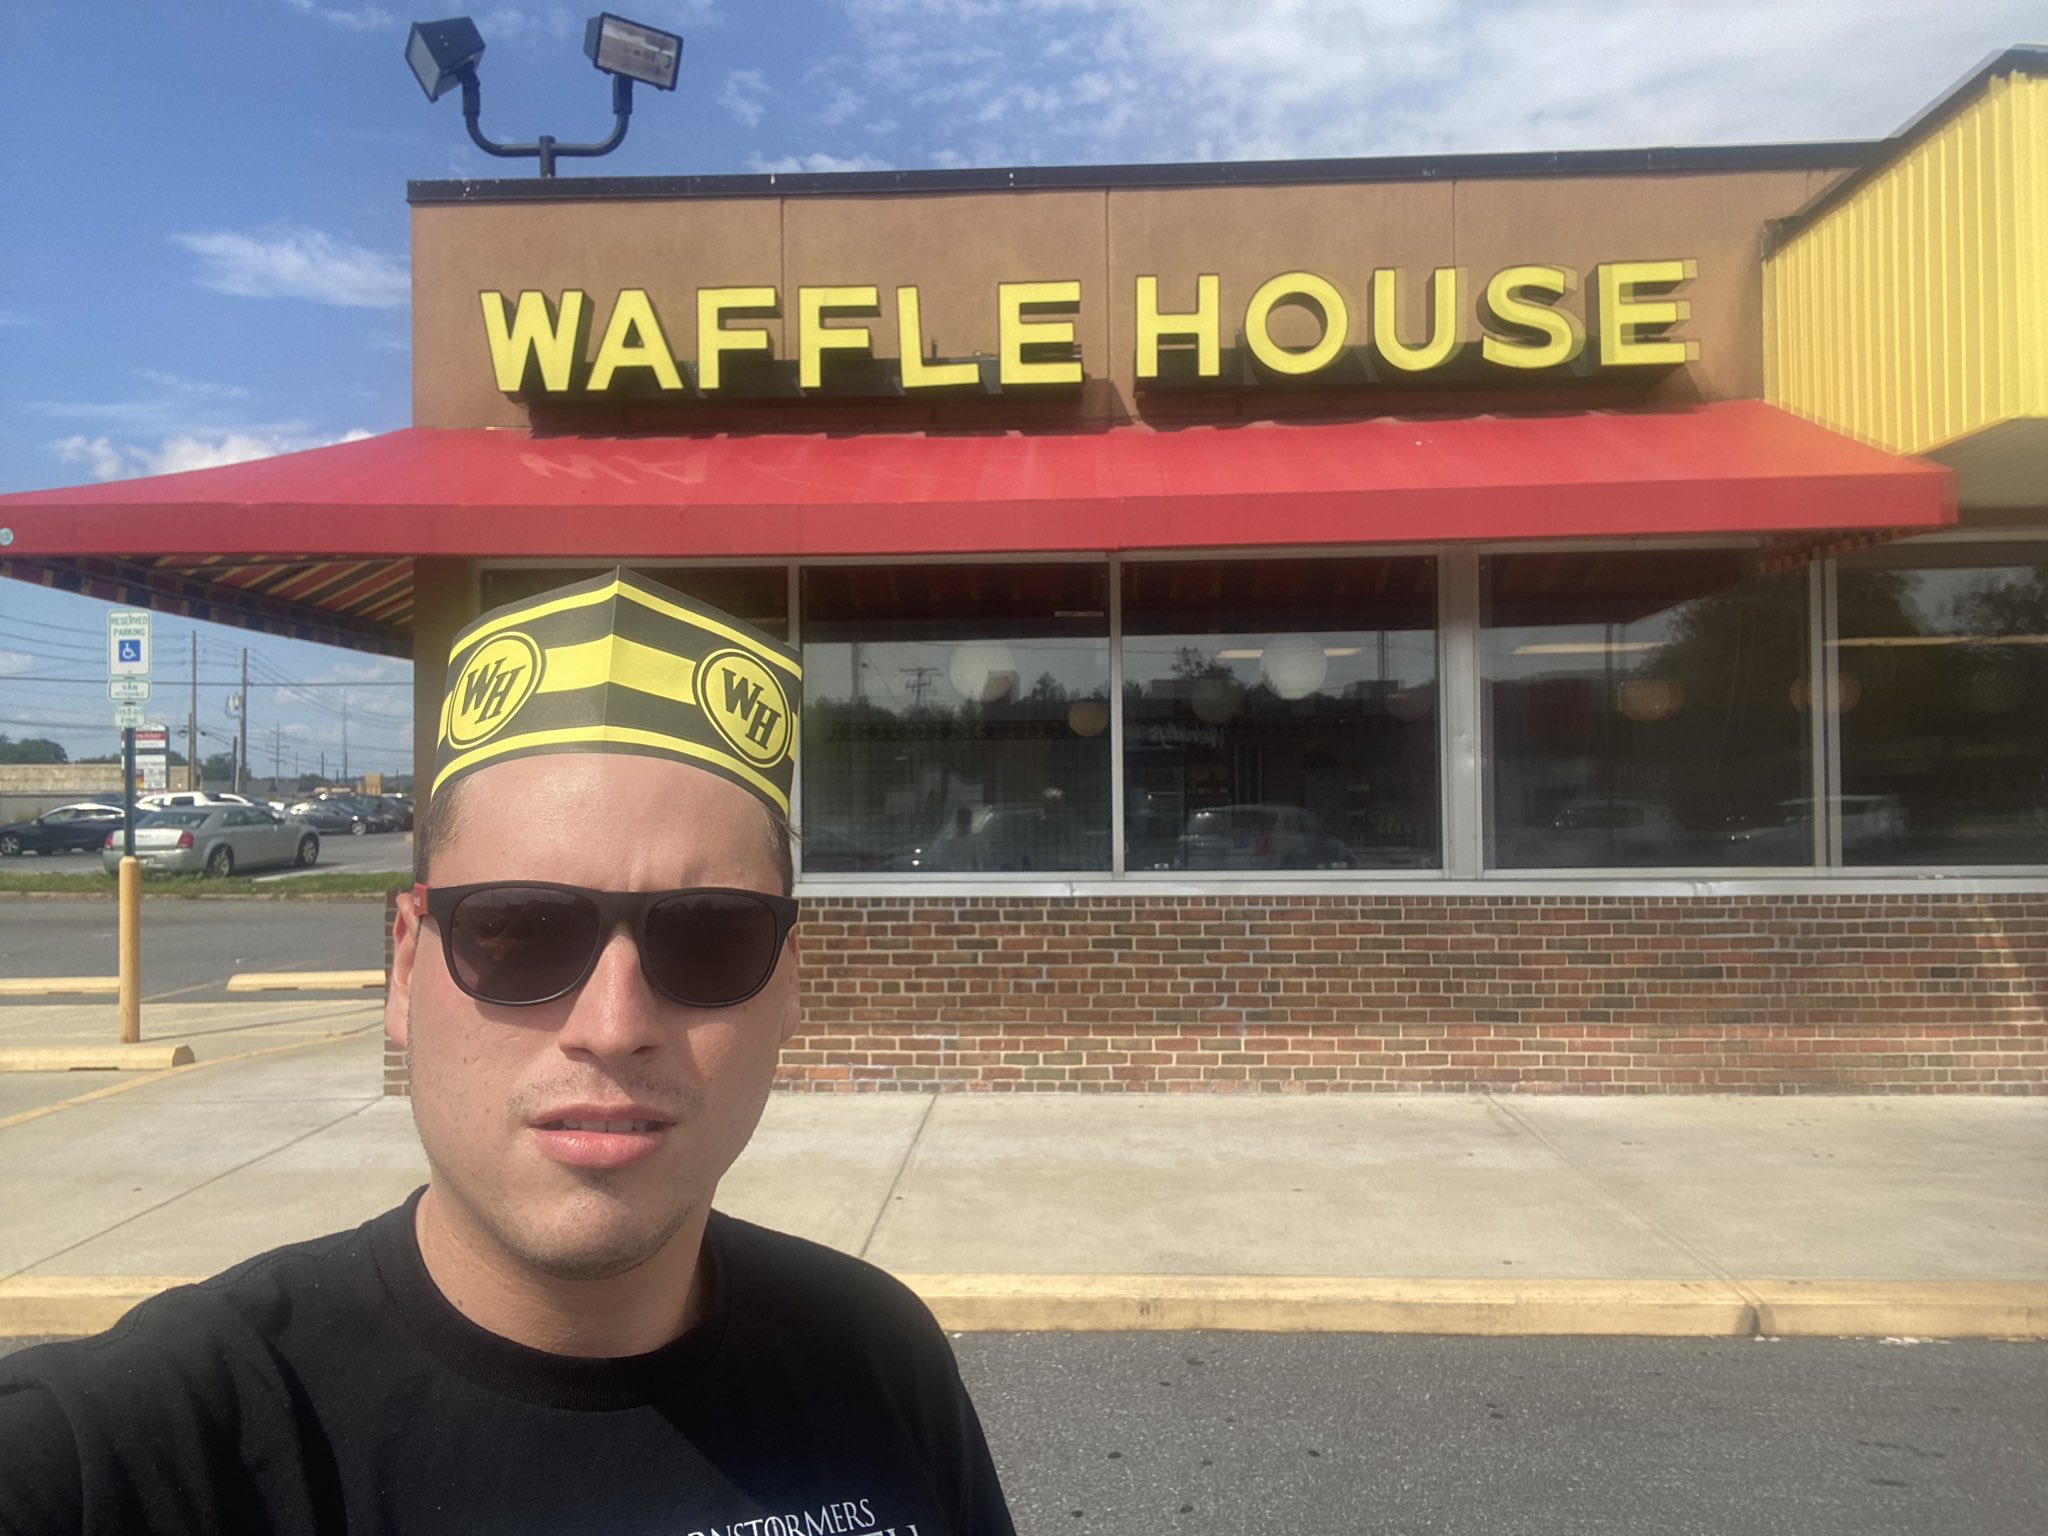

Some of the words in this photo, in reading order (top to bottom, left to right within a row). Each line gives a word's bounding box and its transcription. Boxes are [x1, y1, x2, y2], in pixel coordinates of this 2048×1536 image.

[478, 280, 1083, 393] WAFFLE
[1136, 257, 1699, 378] HOUSE
[110, 616, 148, 626] RESERVED
[114, 628, 145, 636] PARKING
[460, 656, 525, 725] WH
[720, 667, 782, 750] WH
